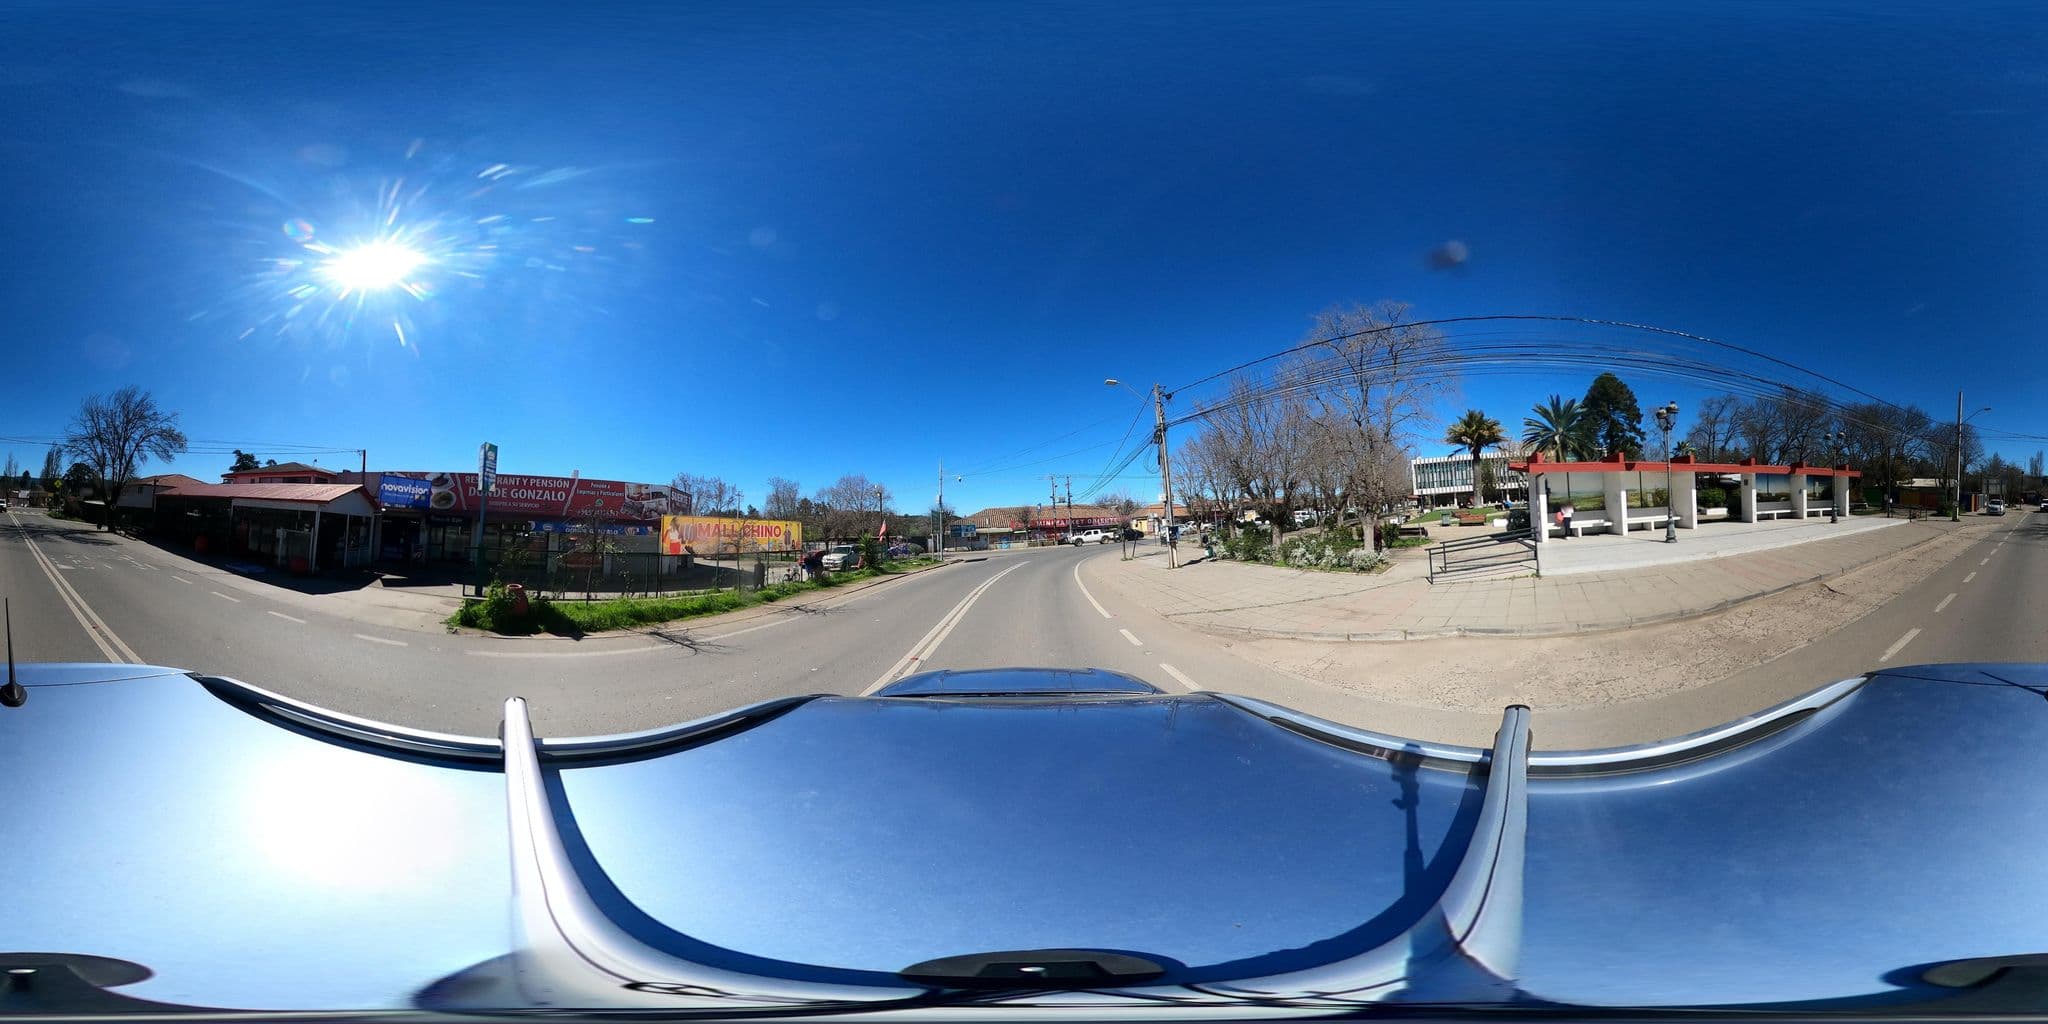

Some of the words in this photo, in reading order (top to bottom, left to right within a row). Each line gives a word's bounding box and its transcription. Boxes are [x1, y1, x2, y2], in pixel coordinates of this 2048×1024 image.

[381, 483, 429, 495] novavision
[522, 478, 528, 486] Y
[530, 478, 570, 489] PENSIÓN
[511, 489, 566, 502] GONZALO
[698, 523, 738, 538] MALL
[742, 524, 781, 538] CHINO
